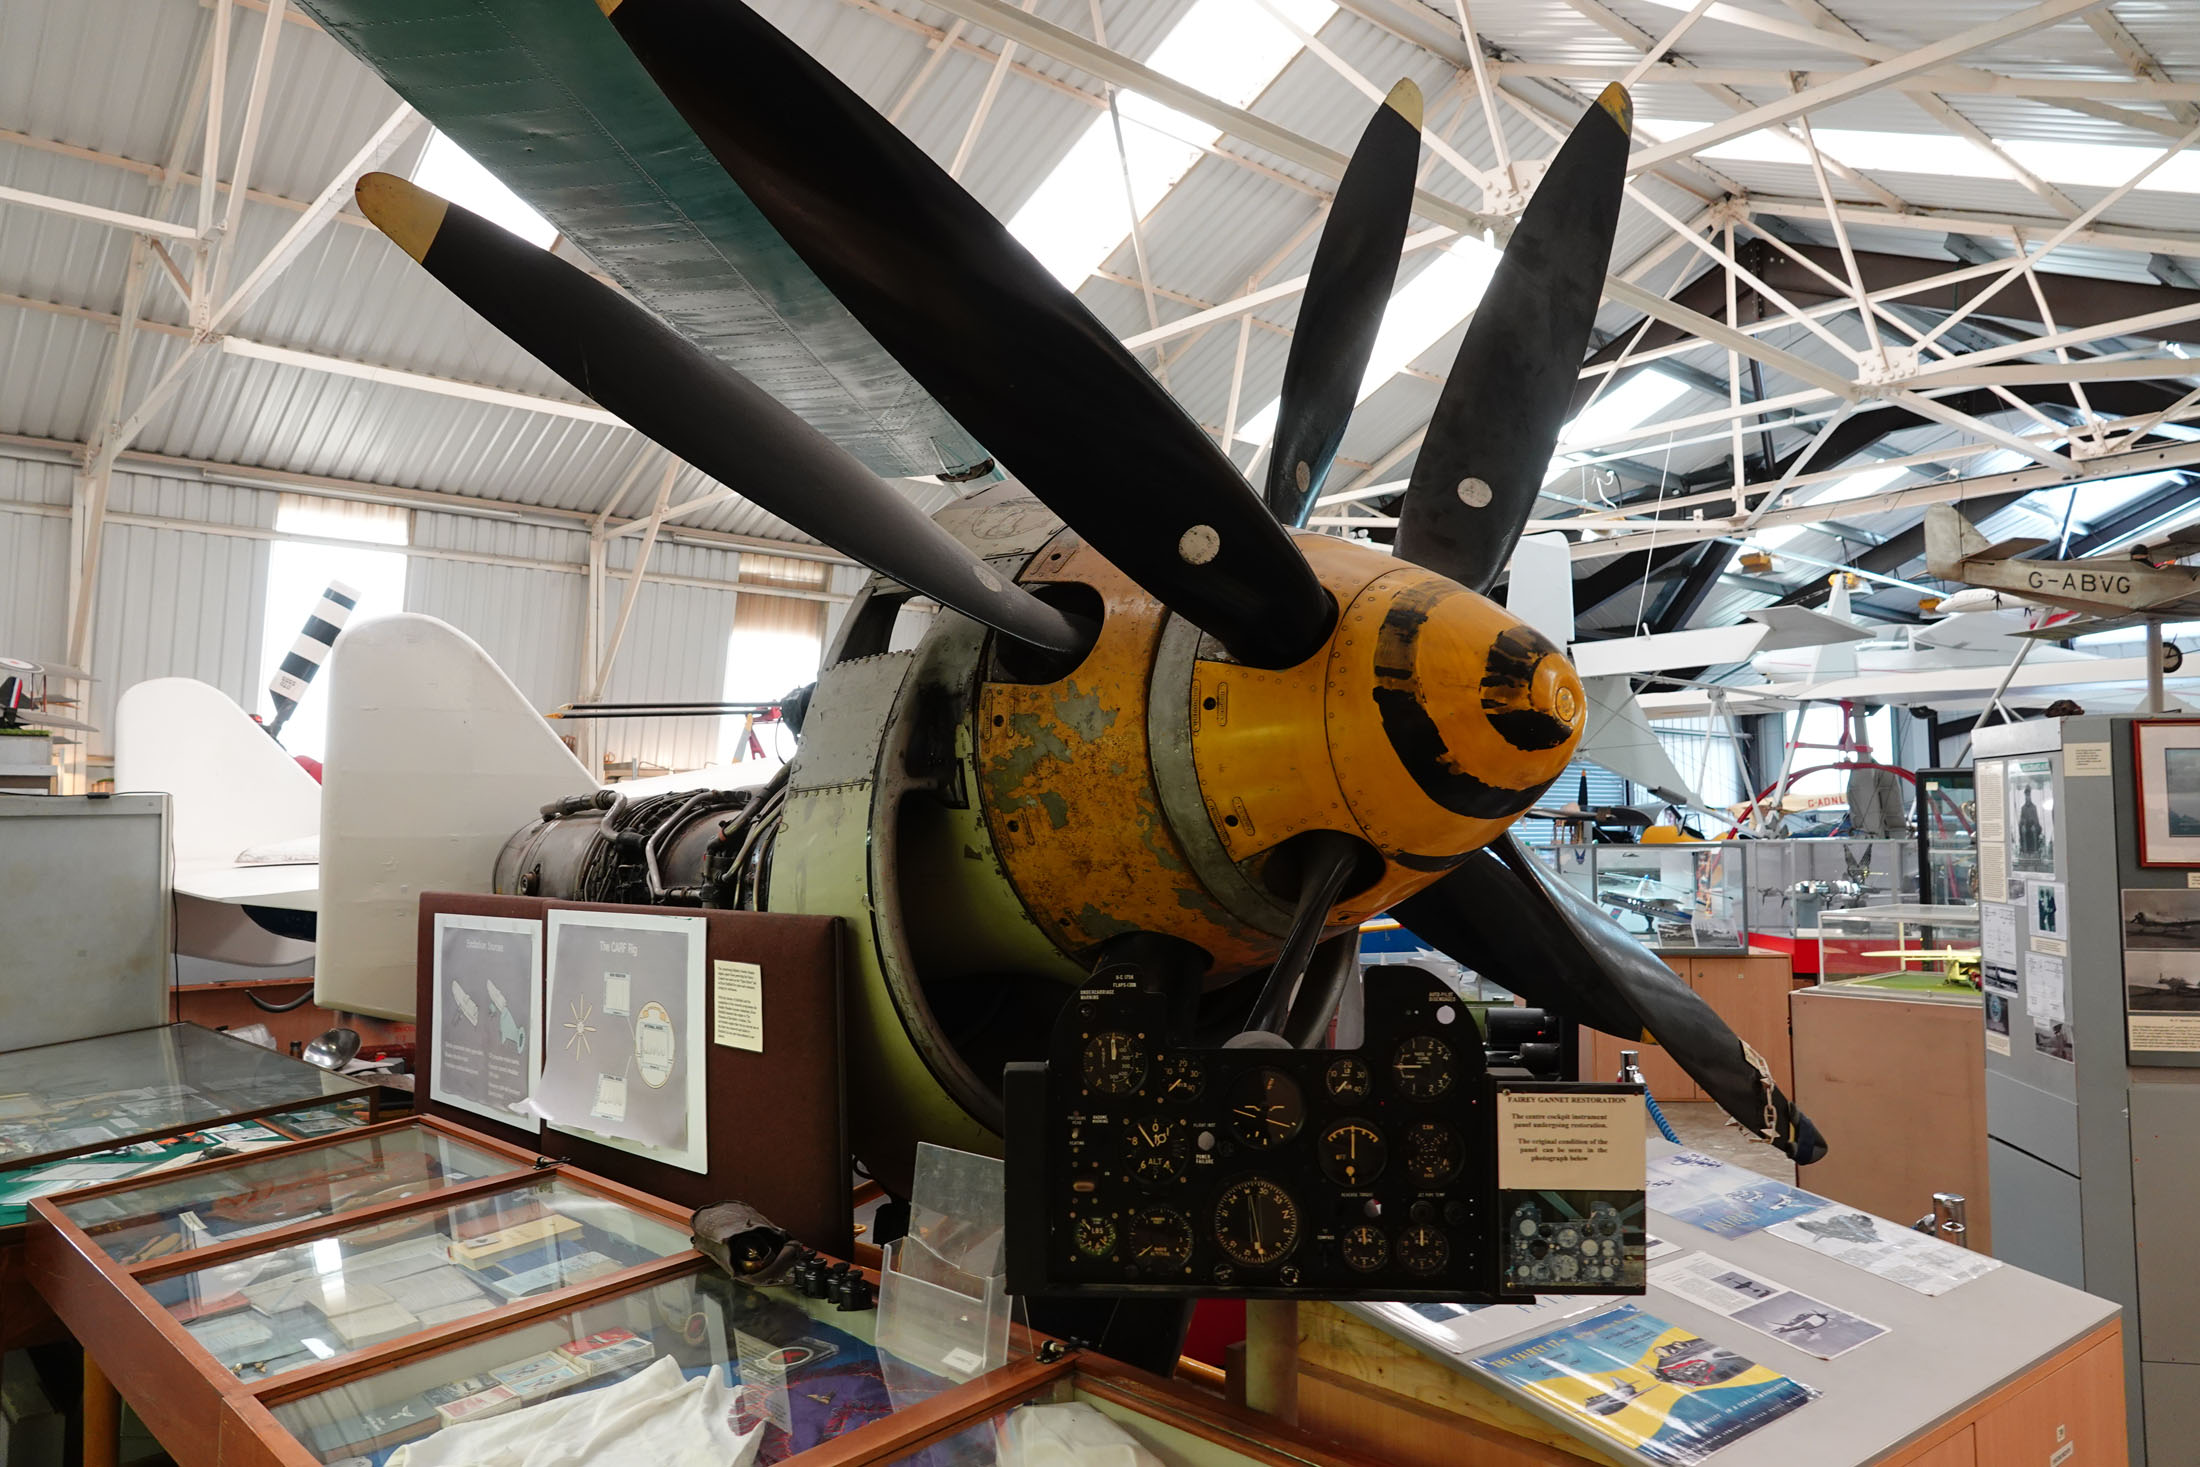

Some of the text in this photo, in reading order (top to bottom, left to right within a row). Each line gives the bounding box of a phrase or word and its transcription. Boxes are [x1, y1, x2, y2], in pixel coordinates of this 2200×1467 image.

[2029, 571, 2131, 594] G-ABVG
[600, 941, 610, 952] The
[1507, 1096, 1627, 1104] FAIREY GANNET RESTORATION
[1547, 1113, 1570, 1122] cockpit
[1513, 1121, 1532, 1129] panel
[1533, 1121, 1569, 1129] undergoing
[1532, 1138, 1557, 1146] original
[1148, 1157, 1163, 1165] ALT
[1531, 1155, 1568, 1163] photograph
[1091, 1226, 1104, 1235] LBS
[1489, 1357, 1515, 1369] THE
[1510, 1344, 1550, 1361] FAIREY
